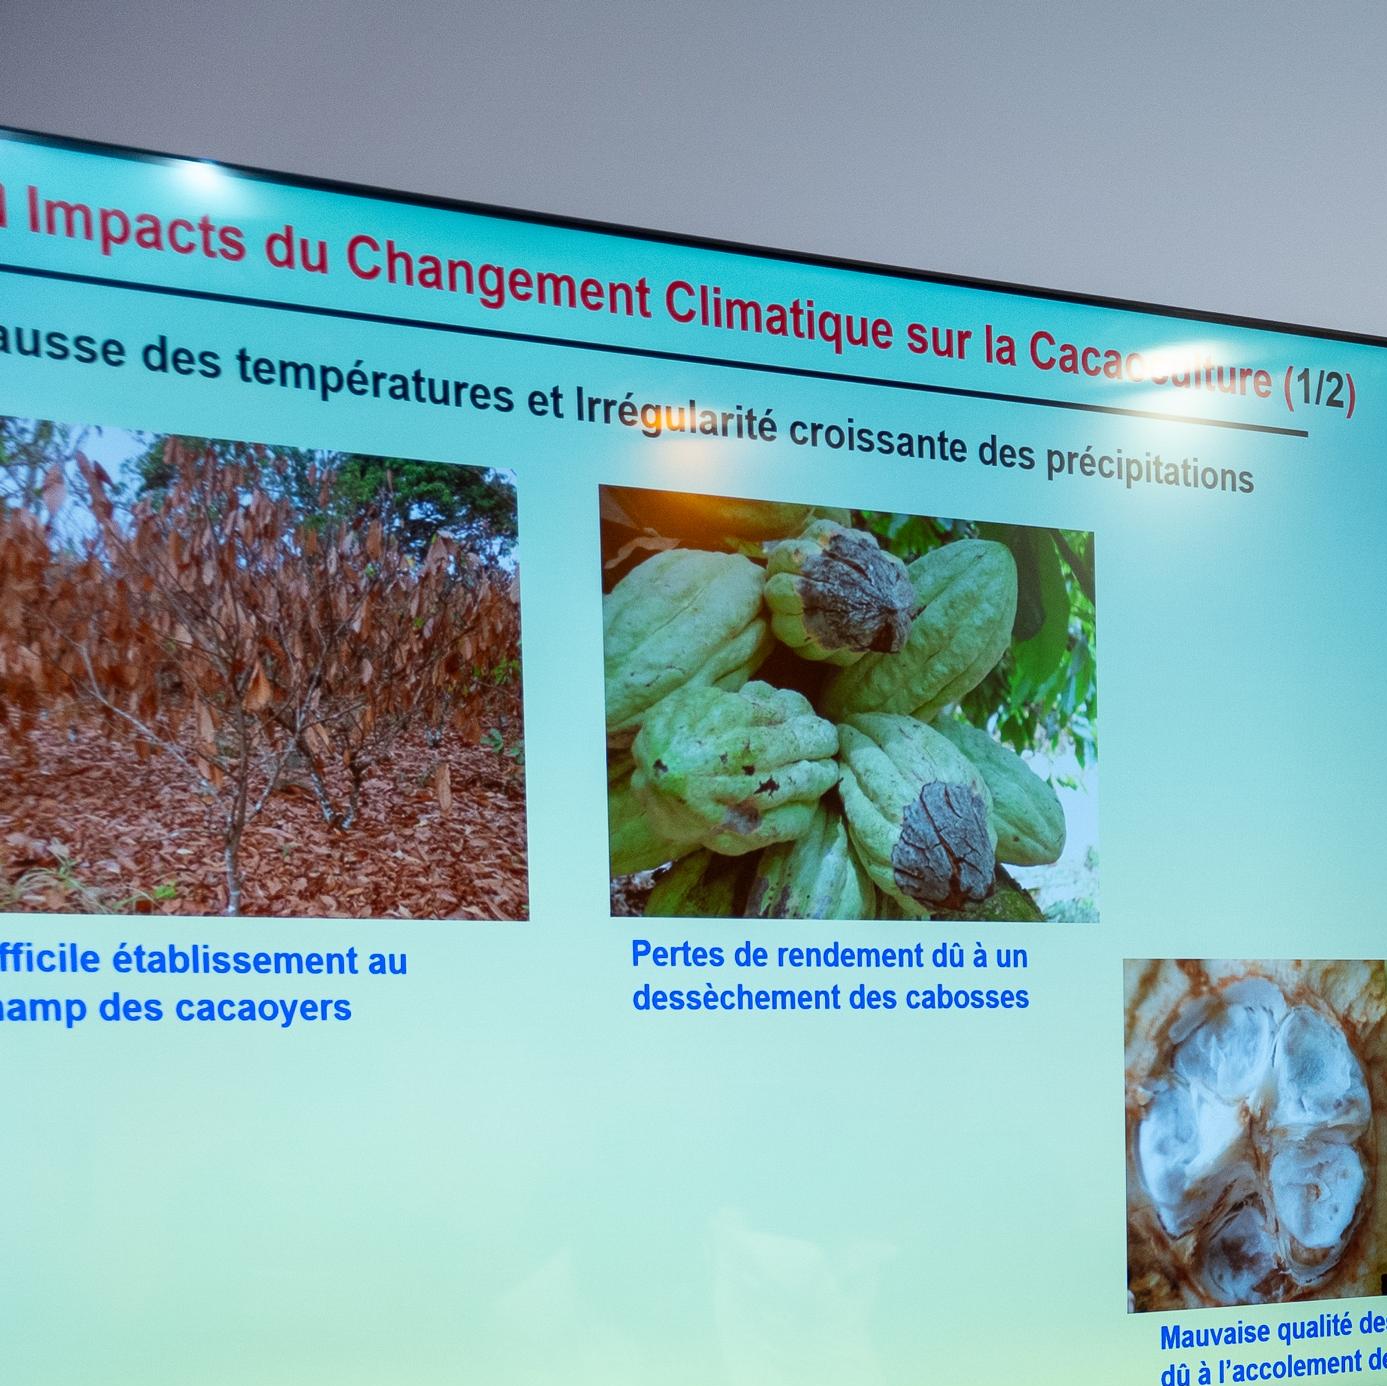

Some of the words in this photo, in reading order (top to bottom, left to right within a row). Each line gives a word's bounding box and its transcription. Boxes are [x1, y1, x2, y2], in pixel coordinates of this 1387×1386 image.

[27, 184, 247, 263] Impacts
[264, 224, 329, 277] du
[346, 234, 652, 319] Changement
[665, 278, 894, 356] Climatique
[907, 320, 971, 361] sur
[984, 323, 1017, 368] la
[1283, 365, 1356, 420] (1/2)
[0, 323, 126, 368] ausse
[142, 333, 222, 380] des
[235, 347, 515, 413] températures
[526, 378, 564, 421] et
[576, 385, 778, 443] Irrégularité
[788, 418, 968, 464] croissante
[978, 432, 1036, 472] des
[1046, 444, 1255, 494] précipitations
[0, 941, 101, 973] fficile
[112, 941, 359, 976] établissement
[368, 952, 408, 975] au
[631, 939, 726, 968] Pertes
[734, 940, 769, 968] de
[777, 941, 924, 968] rendement
[932, 942, 965, 969] dû
[972, 942, 988, 968] à
[996, 946, 1029, 968] un
[0, 998, 87, 1029] amp
[99, 991, 164, 1022] des
[175, 997, 352, 1029] cacaoyers
[632, 982, 841, 1011] dessèchement
[849, 984, 898, 1010] des
[905, 983, 1030, 1010] cabosses
[1160, 1319, 1271, 1350] Mauvaise
[1277, 1311, 1353, 1346] qualité
[1197, 1361, 1212, 1386] à
[1218, 1348, 1363, 1385] l'accolement
